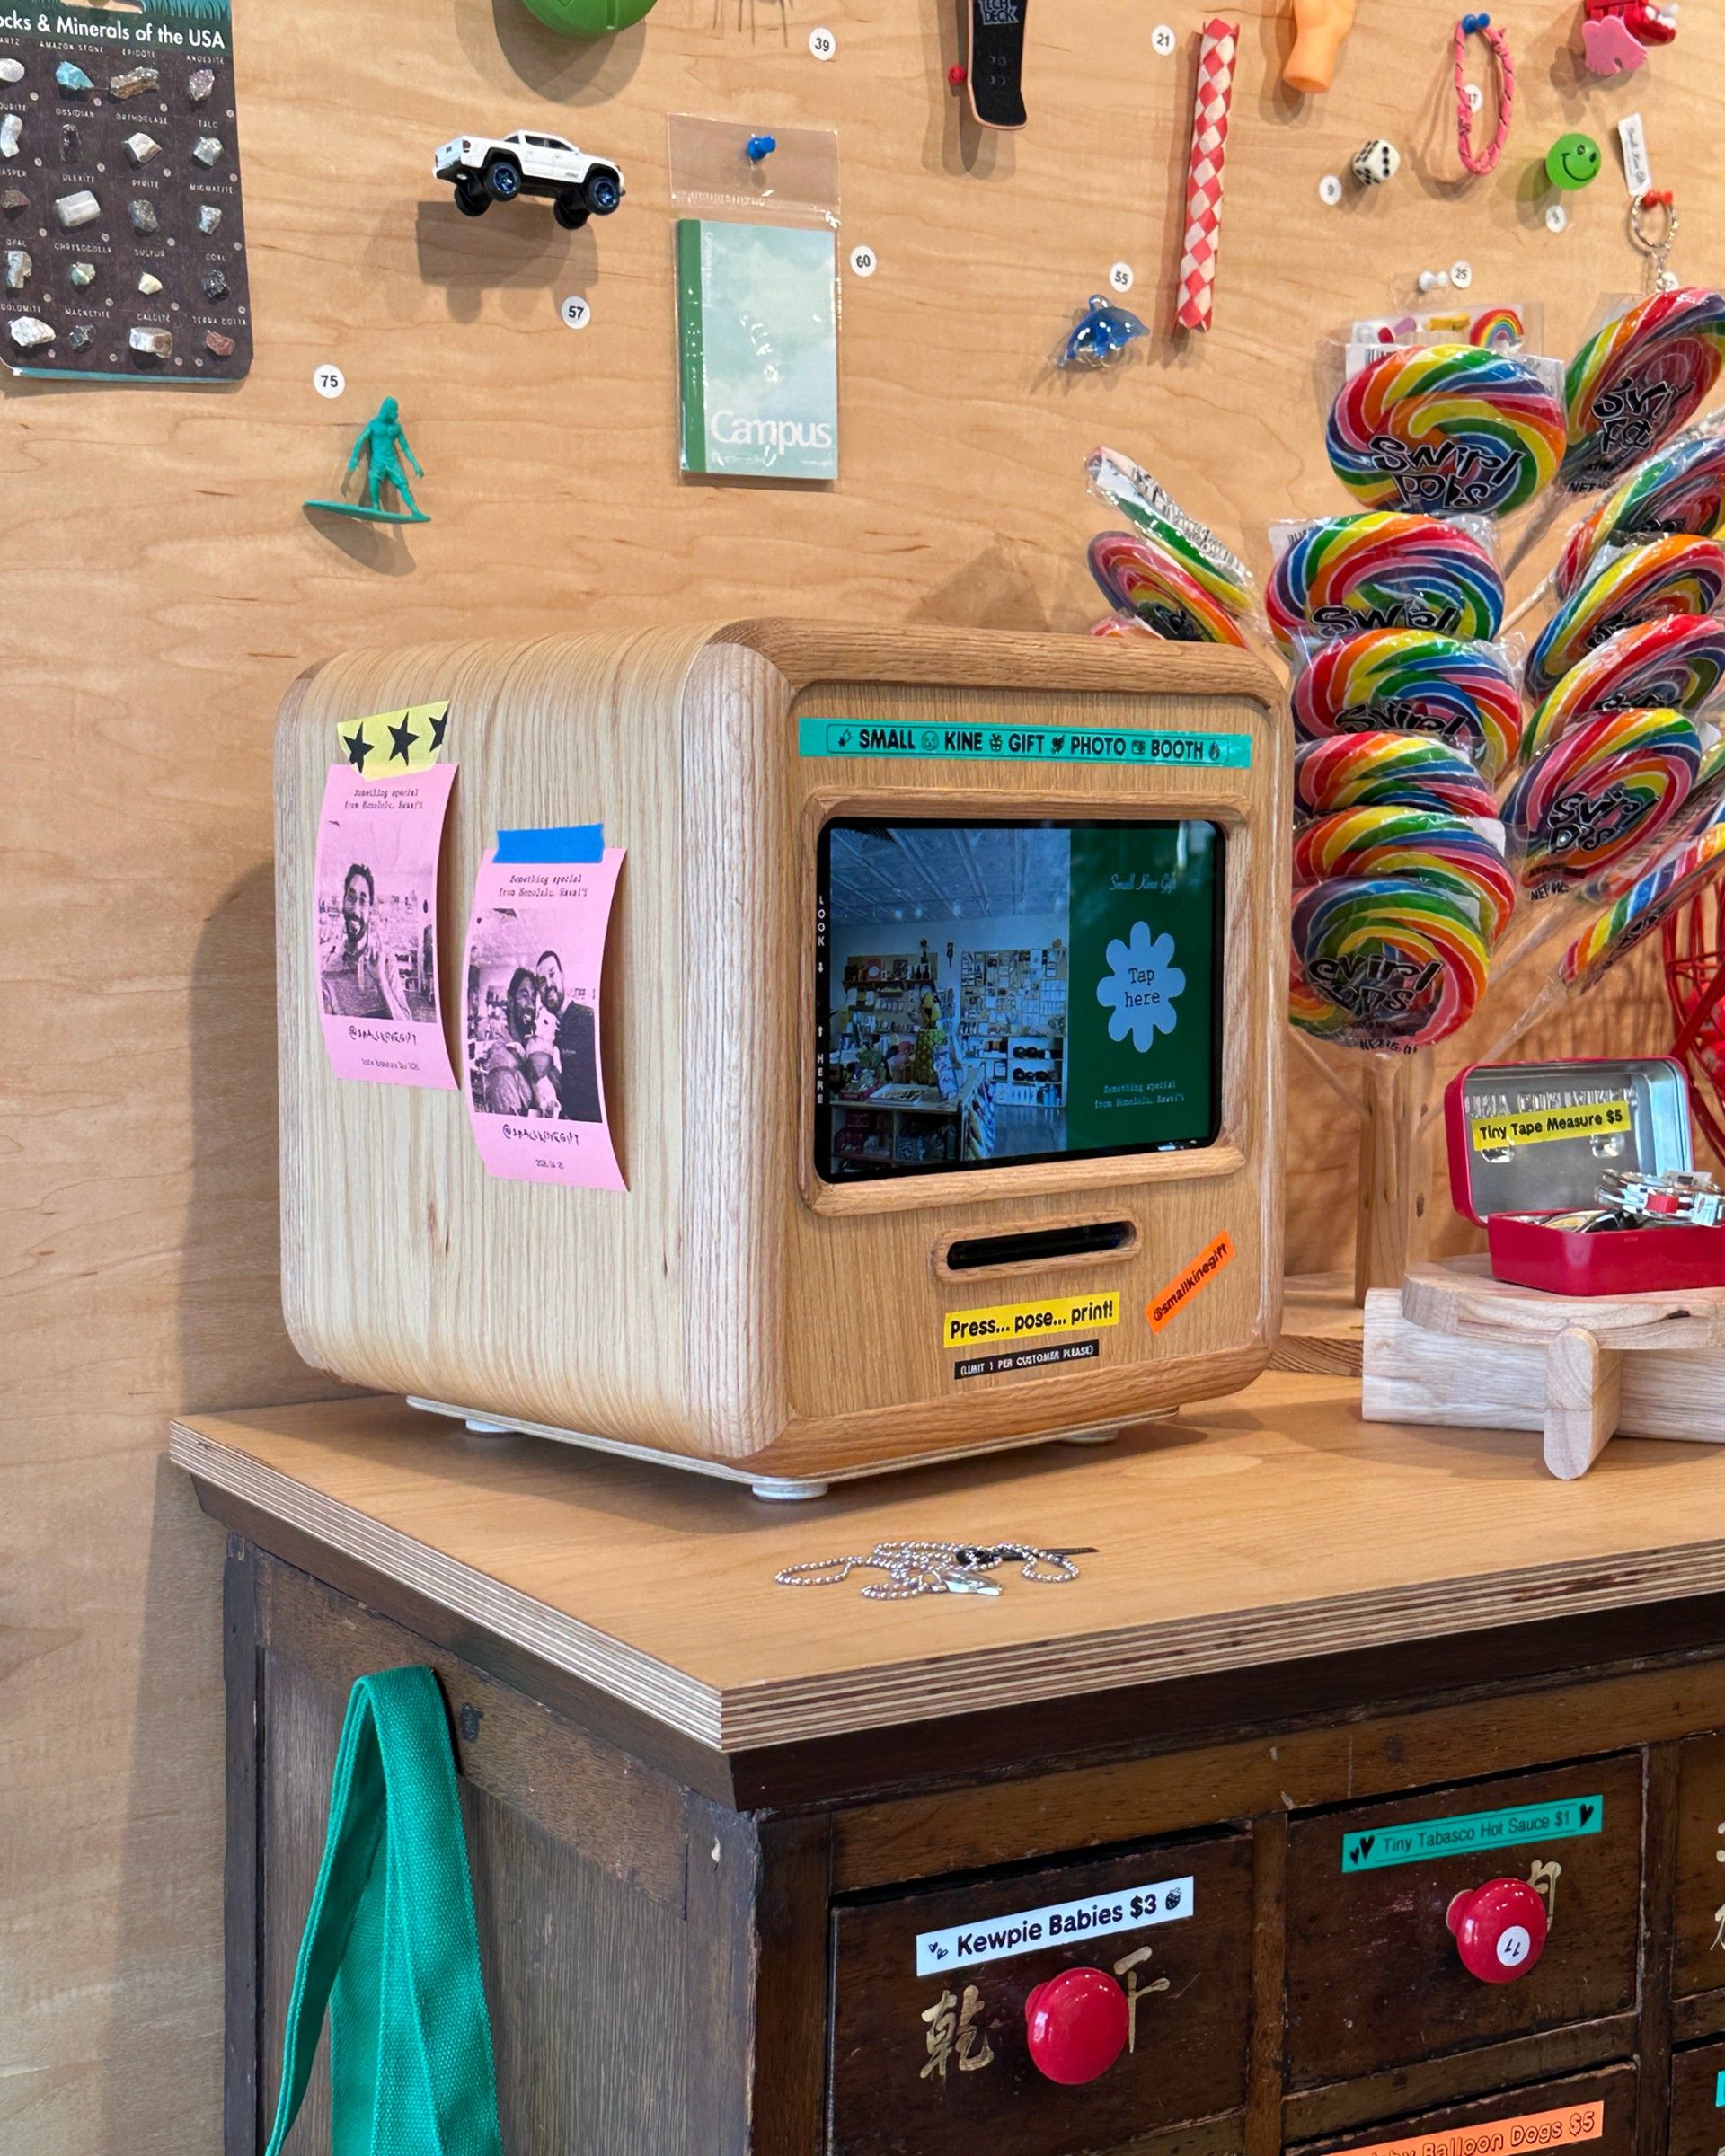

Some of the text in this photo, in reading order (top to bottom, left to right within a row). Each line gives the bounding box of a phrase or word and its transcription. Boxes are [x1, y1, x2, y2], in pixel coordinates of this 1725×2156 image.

[984, 6, 1019, 23] DECK
[0, 9, 226, 49] ocks & Minerals of the USA
[40, 41, 104, 54] AMAZON STONE
[814, 38, 830, 52] 39
[1156, 32, 1171, 47] 21
[56, 107, 94, 119] OBSIDIAN
[198, 119, 218, 129] TALC
[62, 173, 95, 184] ULEXITE
[6, 238, 27, 248] OPAL
[134, 248, 165, 259] SULFUR
[205, 252, 226, 262] COAL
[855, 253, 872, 269] 60
[1114, 270, 1129, 286] 55
[1455, 267, 1468, 280] 25
[0, 303, 41, 314] DOLOMITE
[65, 308, 111, 320] MAGNETITE
[568, 305, 585, 320] 57
[137, 313, 171, 323] CALCITE
[320, 375, 339, 388] 75
[711, 410, 833, 455] Campus
[859, 729, 1204, 761] SMALL KINE GIFT PHOTO BOOTH
[817, 896, 826, 946] LOOK
[1128, 967, 1154, 986] Tap
[1125, 991, 1161, 1008] here
[1479, 1109, 1623, 1140] Tiny Tape Measure $5
[1153, 1241, 1228, 1321] @smallkinegift
[951, 1300, 1113, 1339] Press... pose... print!
[960, 1363, 985, 1376] (LIMIT
[997, 1358, 1013, 1369] PER
[1016, 1350, 1060, 1366] CUSTOMER
[1063, 1344, 1094, 1358] PLEASE)
[1383, 1810, 1570, 1856] Tiny Tabasco Hot Sauce $1
[957, 1893, 1157, 1957] Kewpie Babies $3
[1422, 2111, 1596, 2156] Balloon Dogs $5
